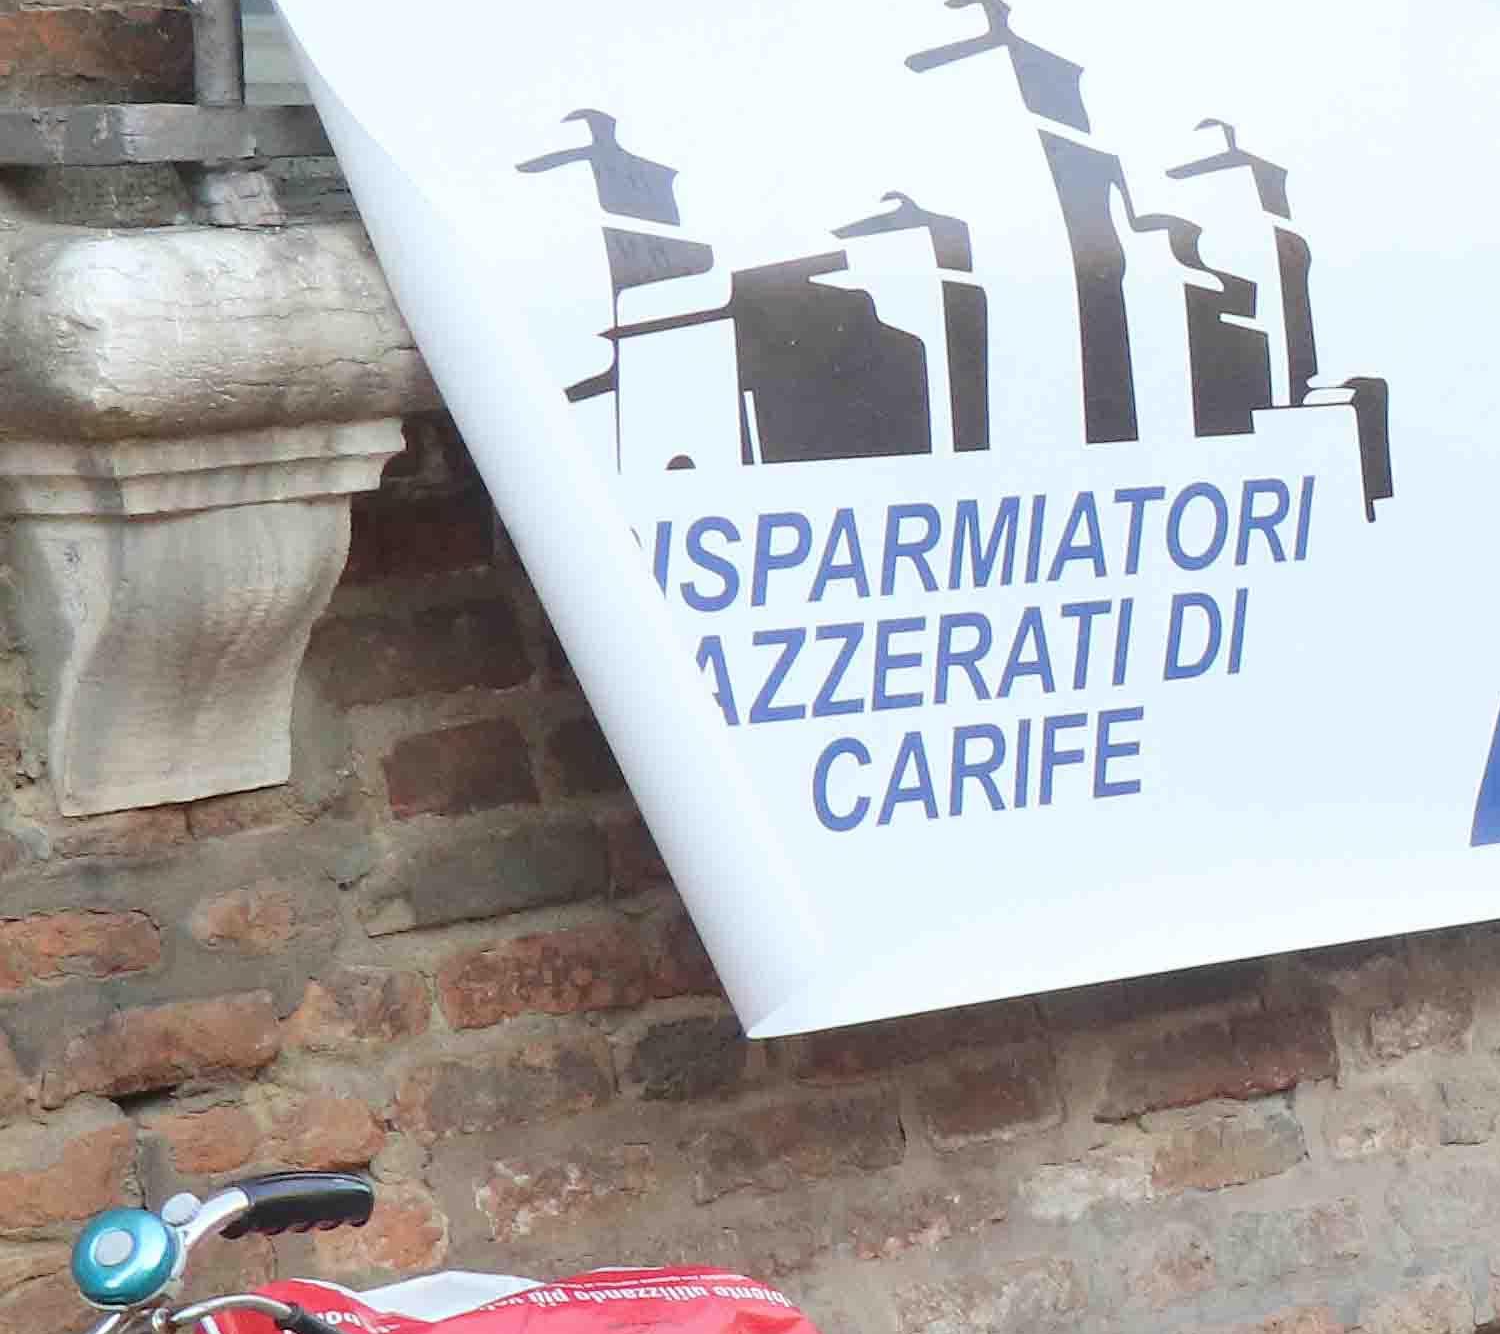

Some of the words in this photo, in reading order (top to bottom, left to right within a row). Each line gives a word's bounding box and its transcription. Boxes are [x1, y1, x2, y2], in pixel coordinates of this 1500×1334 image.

[632, 475, 1316, 613] ISPARMIATORI
[695, 598, 1135, 727] AZZERATI
[1163, 587, 1250, 682] DI
[812, 706, 1145, 833] CARIFE
